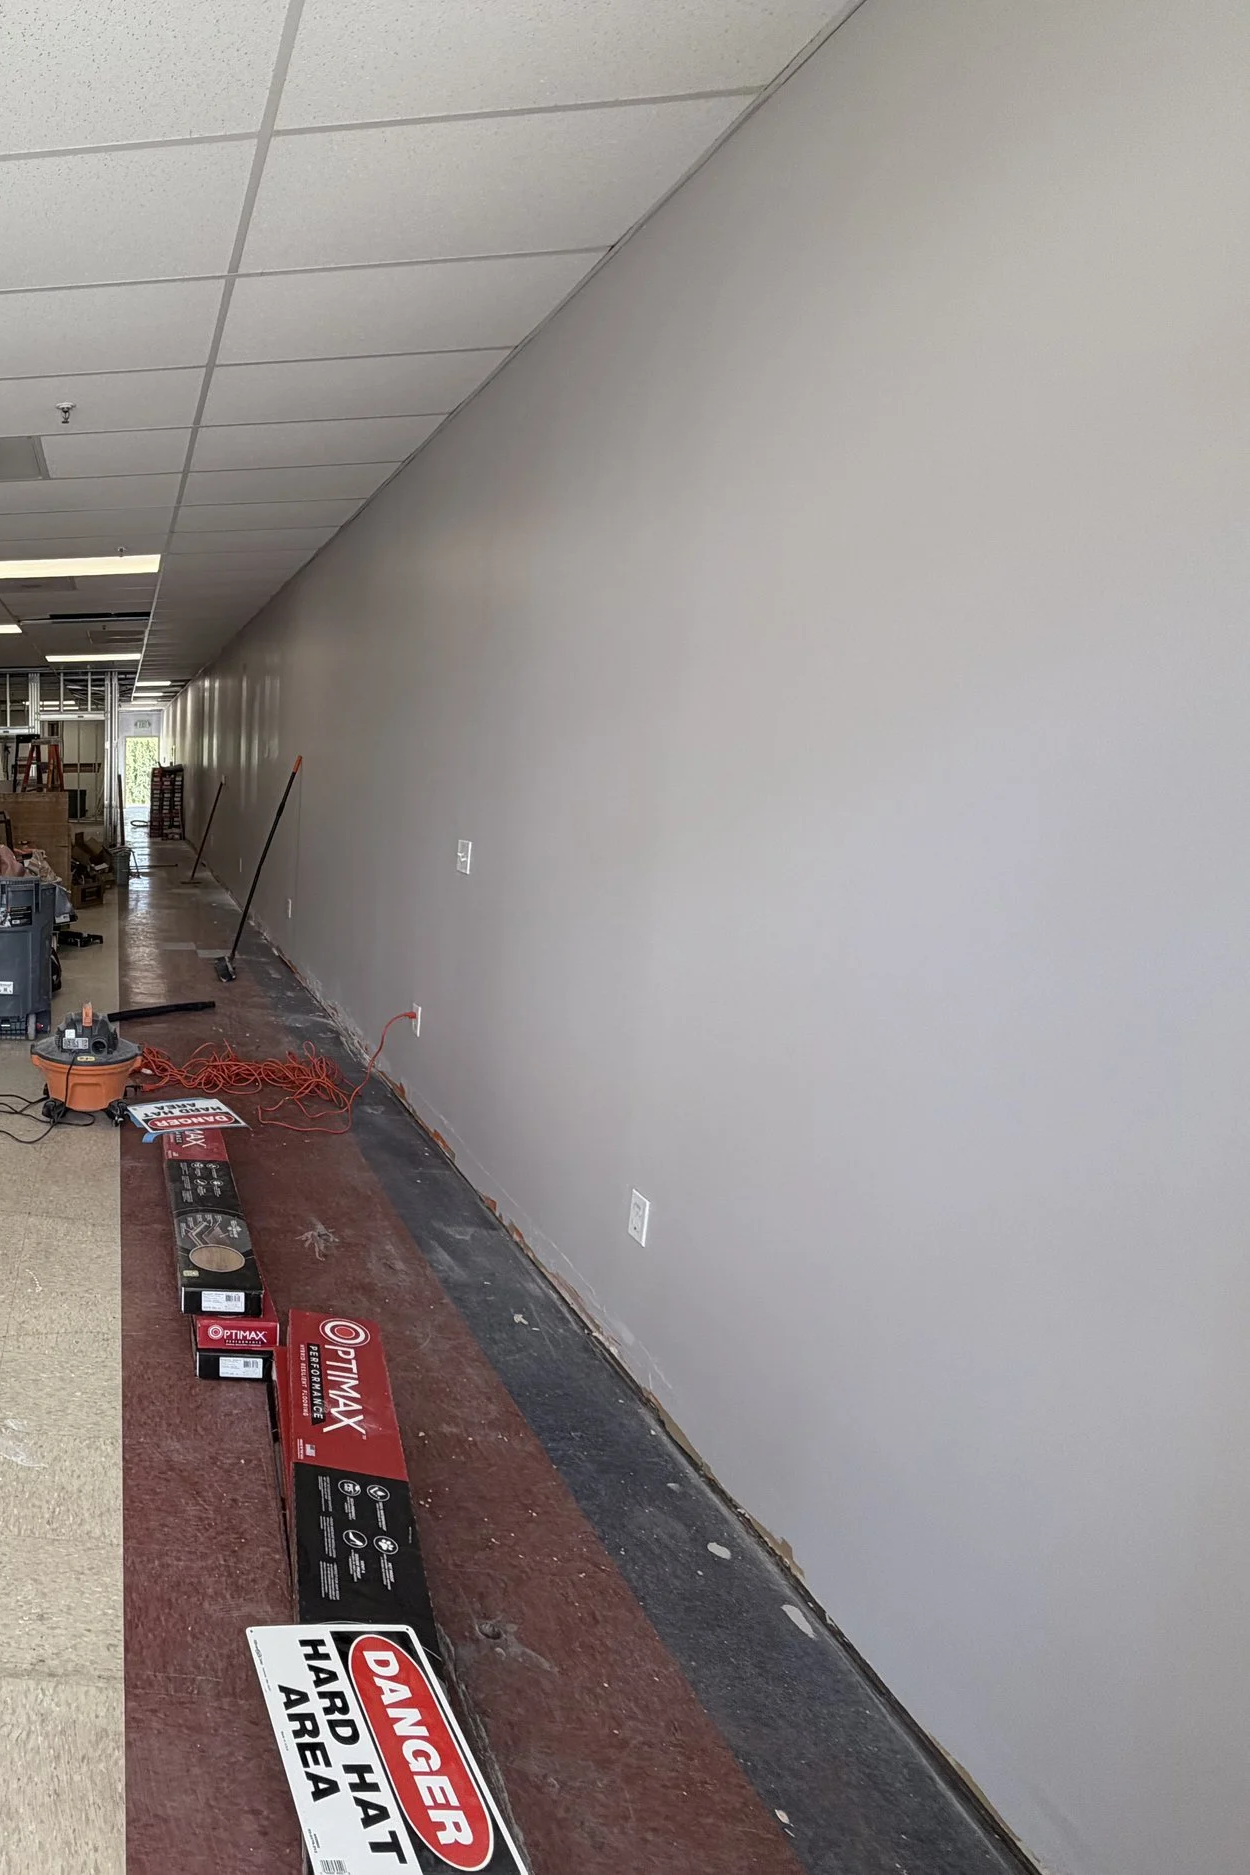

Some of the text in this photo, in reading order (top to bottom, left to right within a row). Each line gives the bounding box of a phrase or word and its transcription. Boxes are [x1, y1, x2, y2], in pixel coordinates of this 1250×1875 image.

[144, 1110, 174, 1118] HAT
[154, 1102, 196, 1110] AREA
[155, 1115, 228, 1127] DANGER
[208, 1325, 267, 1343] OPTIMAX
[309, 1345, 323, 1420] PERFORMANCE
[319, 1318, 371, 1434] OPTIMAX
[301, 1389, 309, 1417] FLOORING
[278, 1684, 341, 1802] AREA
[299, 1638, 408, 1865] HARD HAT
[362, 1650, 474, 1846] DANGER
